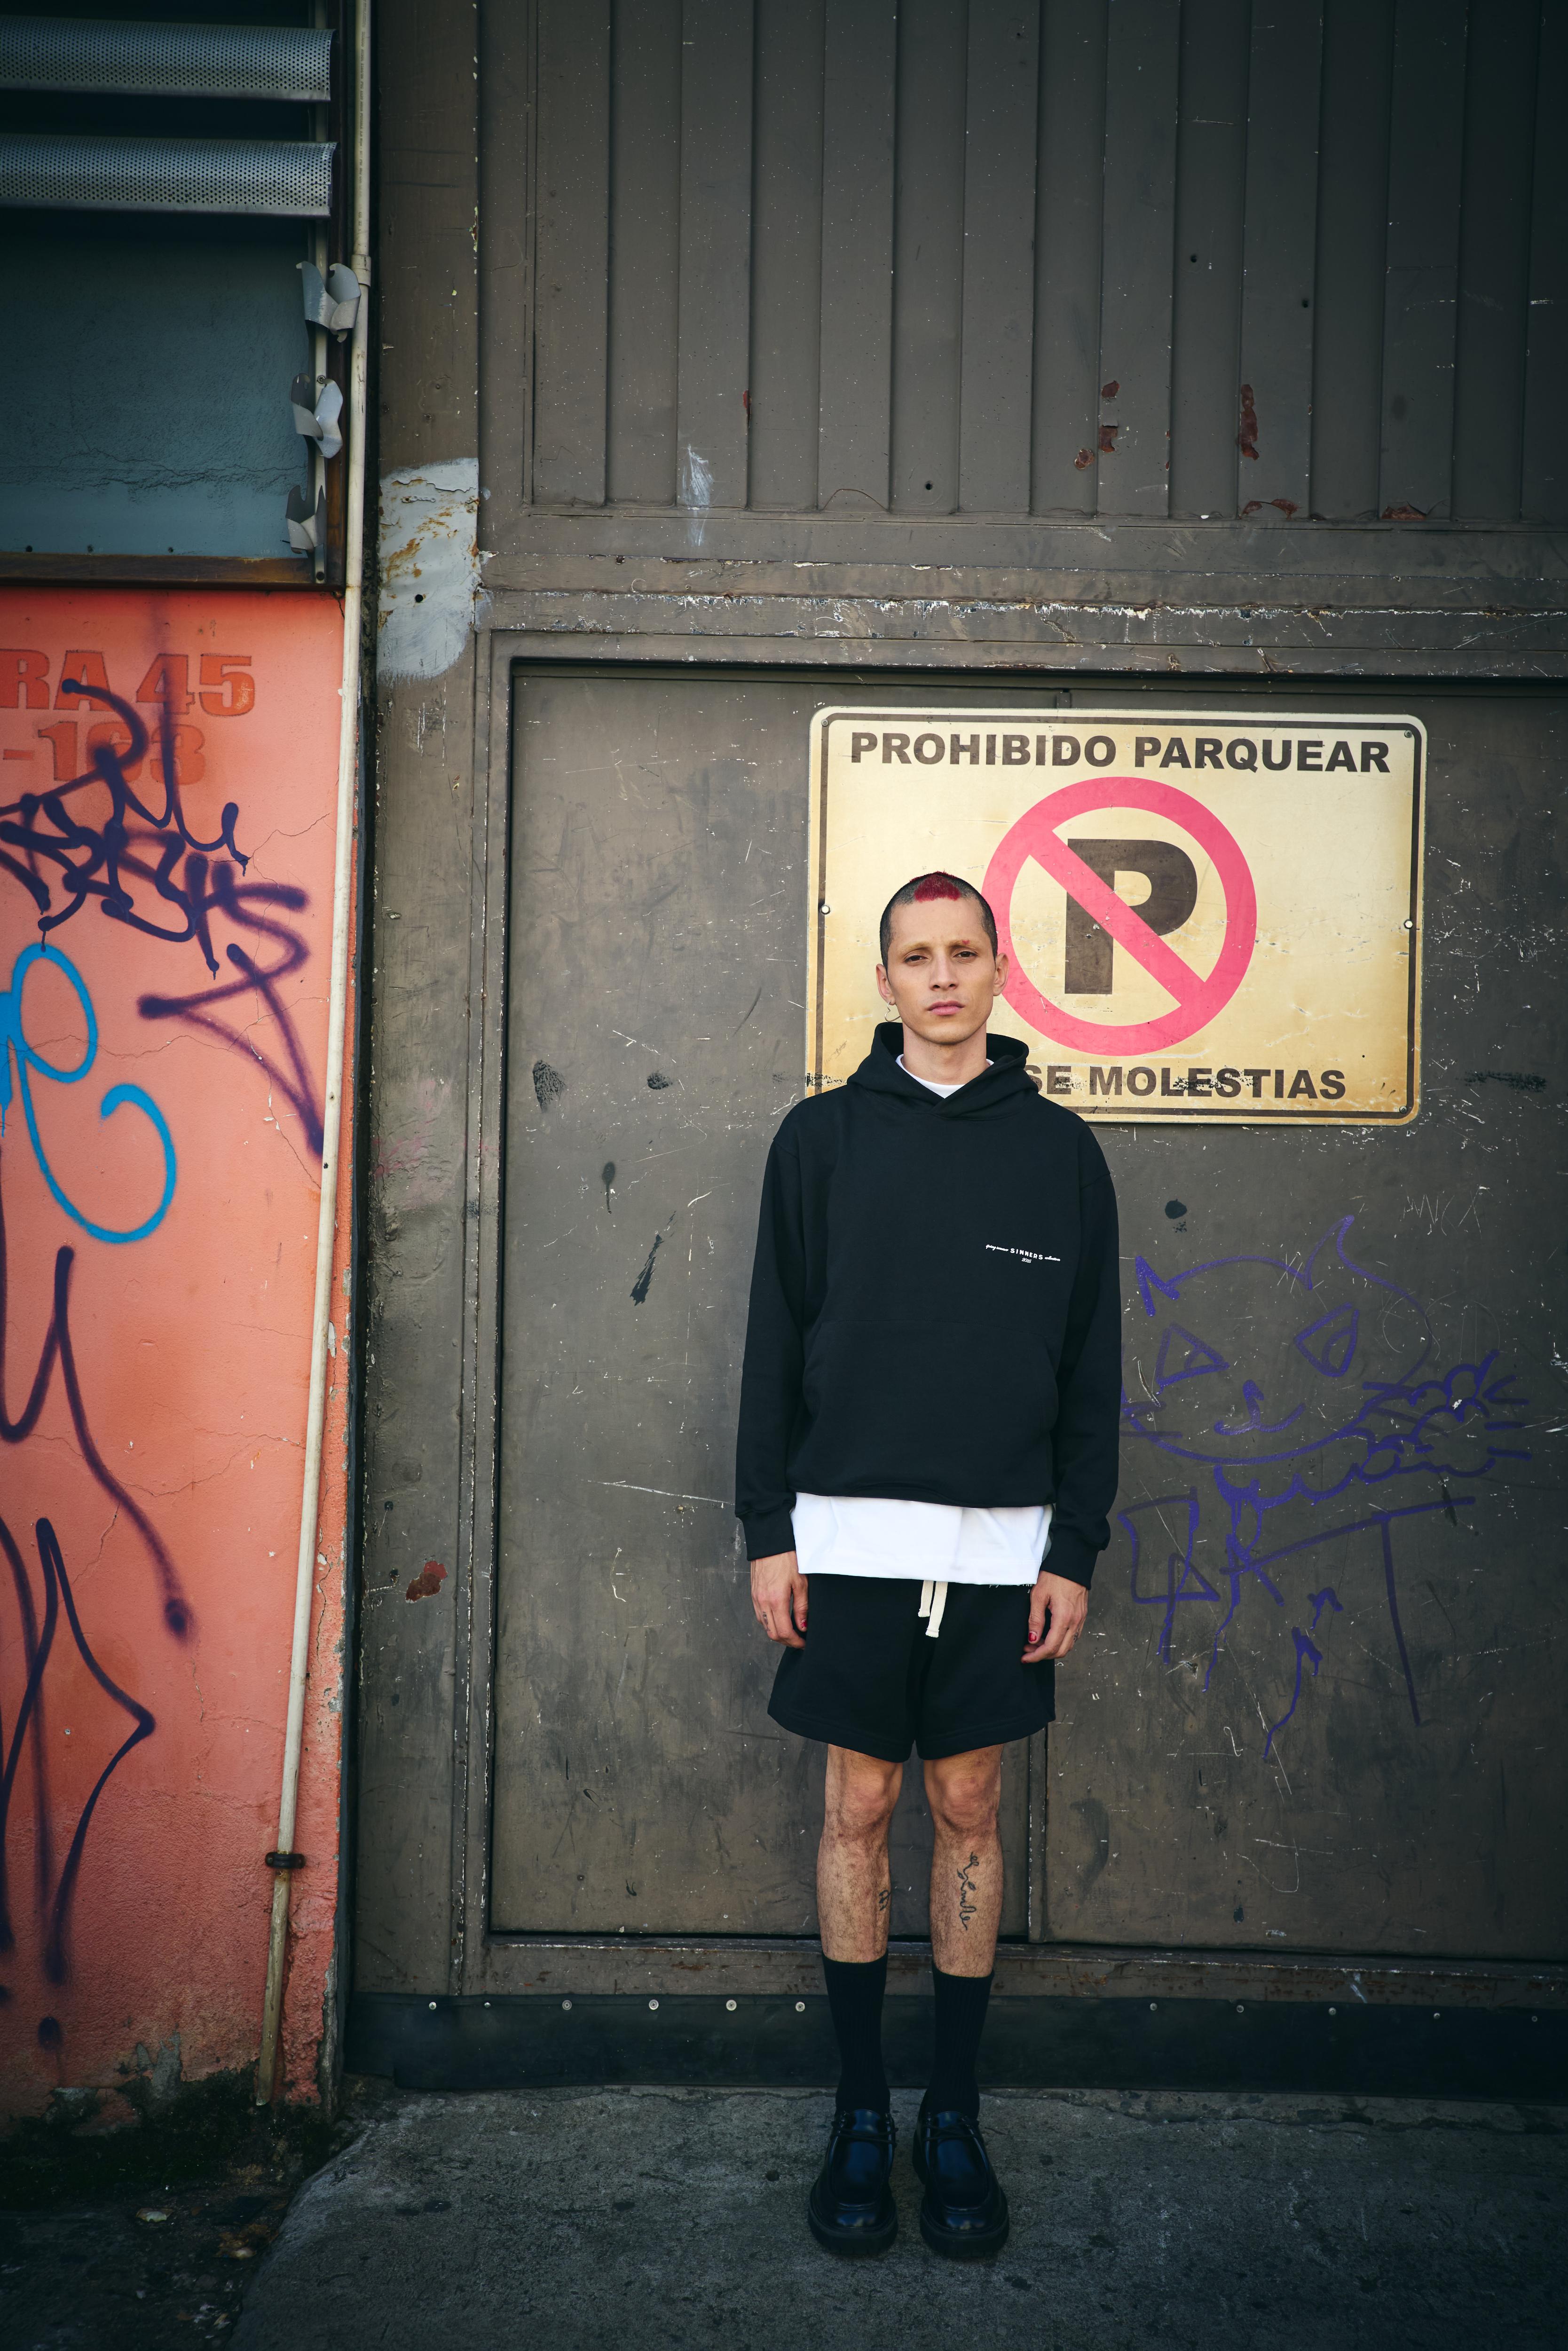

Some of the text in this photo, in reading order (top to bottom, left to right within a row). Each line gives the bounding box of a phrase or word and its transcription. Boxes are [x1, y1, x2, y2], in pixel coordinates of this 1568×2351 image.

[0, 649, 255, 717] RA 45
[851, 732, 1391, 773] PROHIBIDO PARQUEAR
[1064, 838, 1198, 995] P
[1089, 1065, 1346, 1100] MOLESTIAS
[1010, 1248, 1043, 1260] SINNERS
